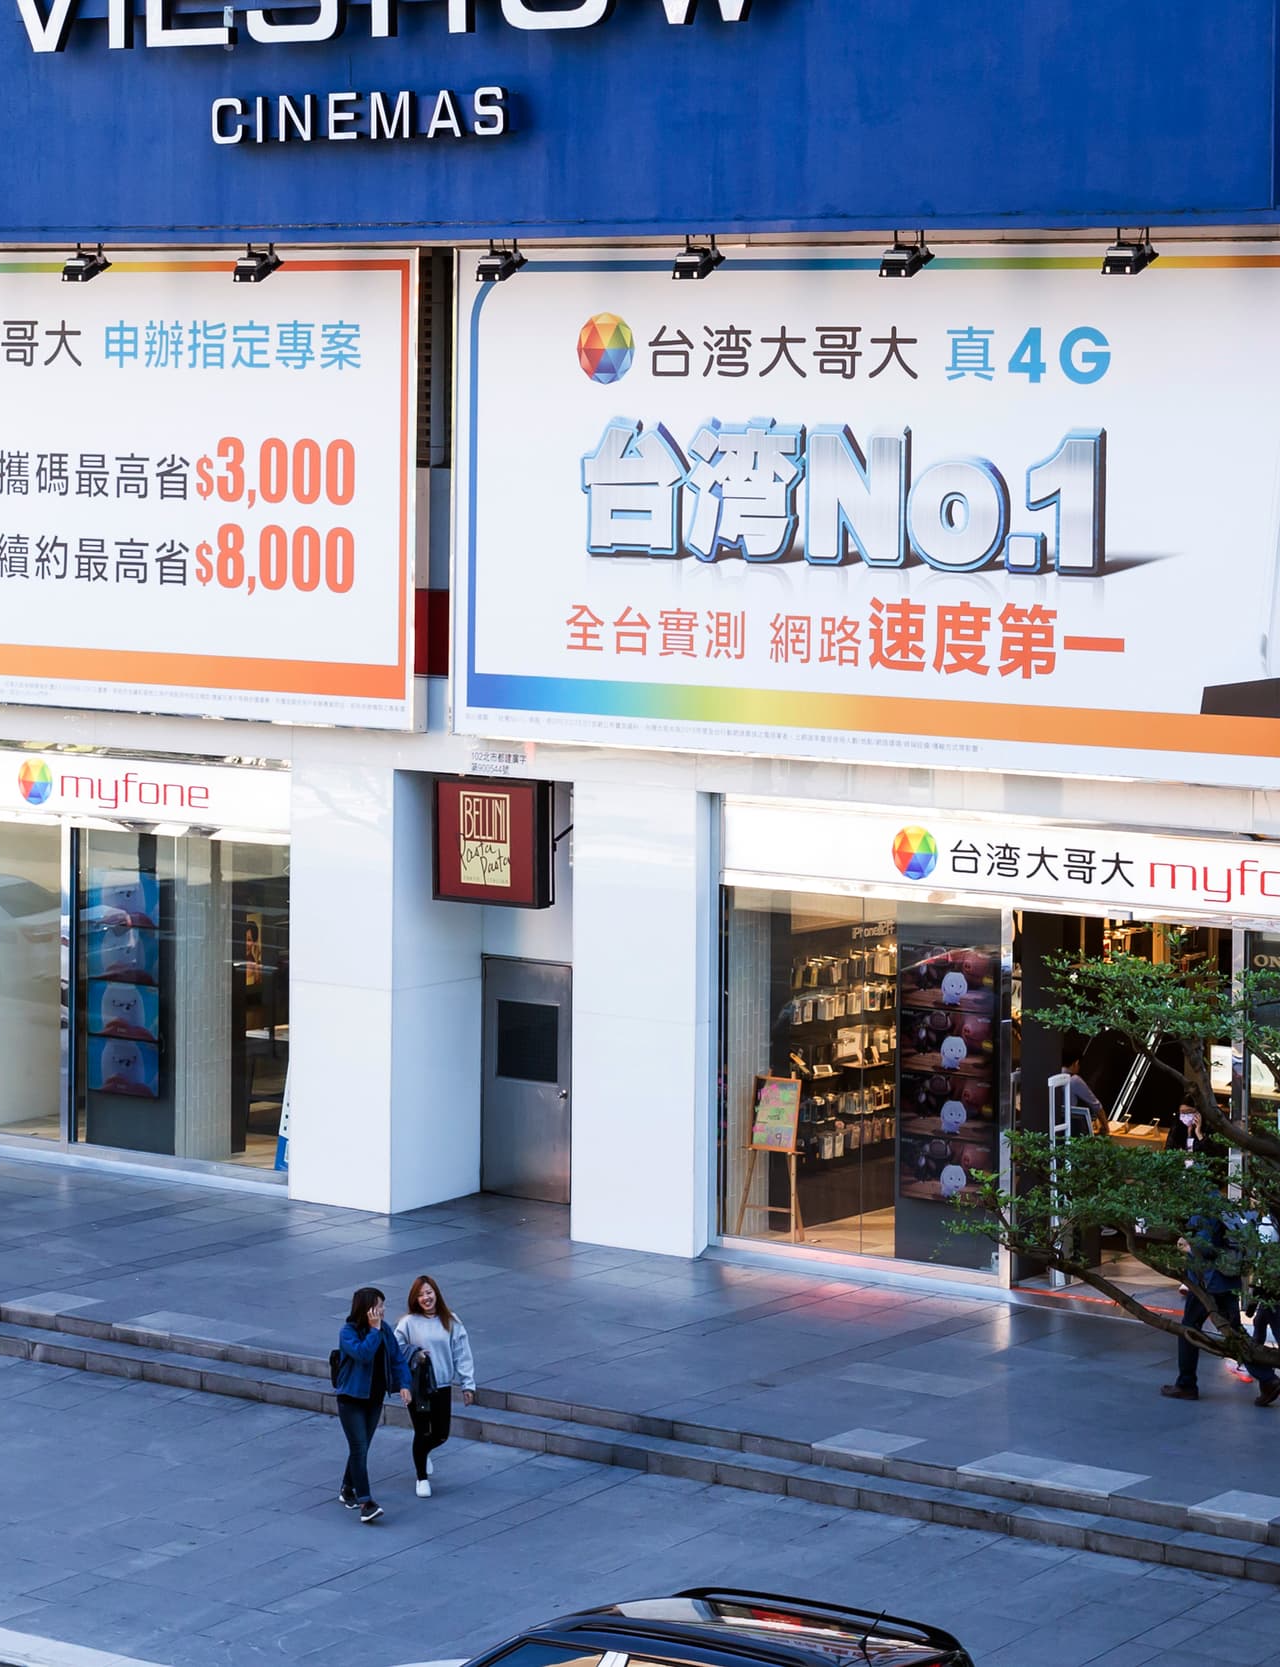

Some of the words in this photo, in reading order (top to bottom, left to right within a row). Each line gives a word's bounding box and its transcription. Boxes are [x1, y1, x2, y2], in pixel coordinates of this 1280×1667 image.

[212, 86, 506, 145] CINEMAS
[104, 320, 362, 371] 申辦指定專案
[647, 324, 919, 381] 台湾大哥大
[945, 325, 1111, 385] 真4G
[581, 416, 1108, 577] 台湾No.1
[566, 603, 746, 663] 全台實測
[769, 598, 1126, 679] 網路速度第一
[60, 772, 209, 810] myfone
[464, 797, 506, 841] BELLINI
[457, 832, 497, 871] Pasta
[950, 839, 1135, 888] 台湾大哥大
